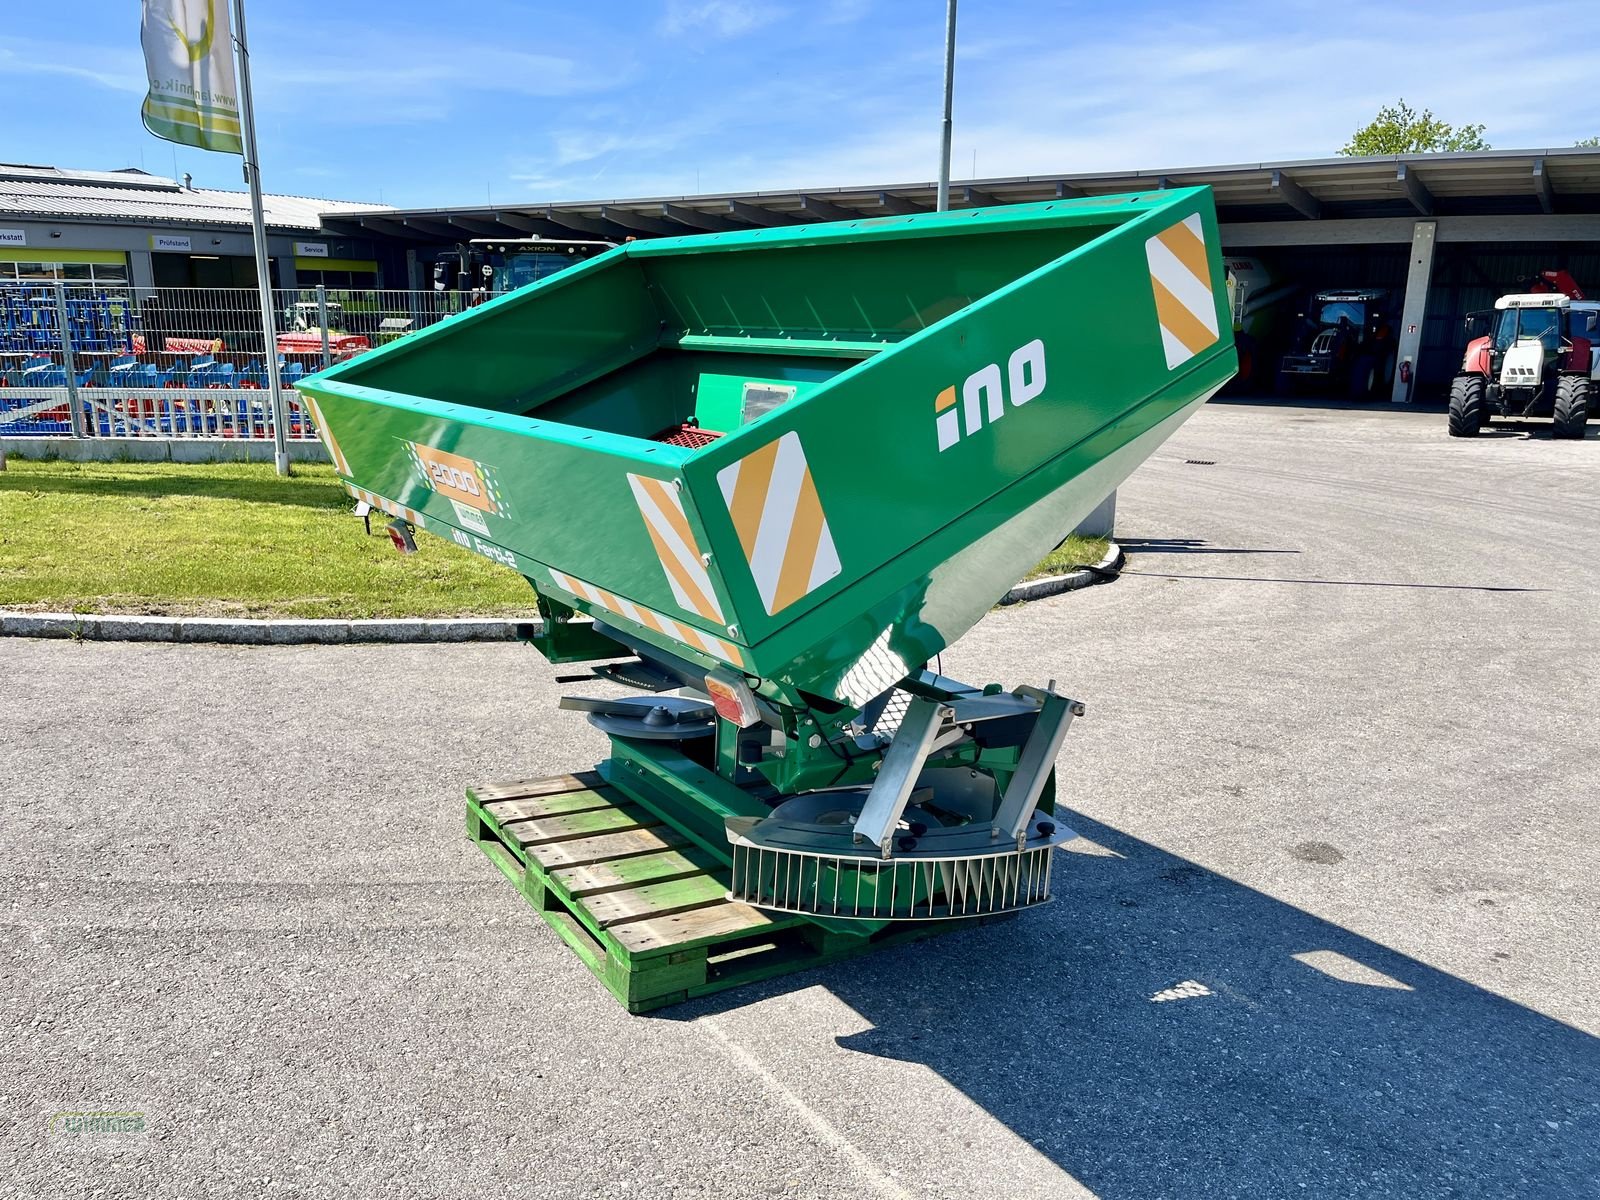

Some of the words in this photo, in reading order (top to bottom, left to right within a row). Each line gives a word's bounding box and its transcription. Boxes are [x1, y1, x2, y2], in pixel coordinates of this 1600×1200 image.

[159, 239, 190, 248] Prüfstand
[304, 246, 324, 254] Service
[428, 460, 480, 497] 2000
